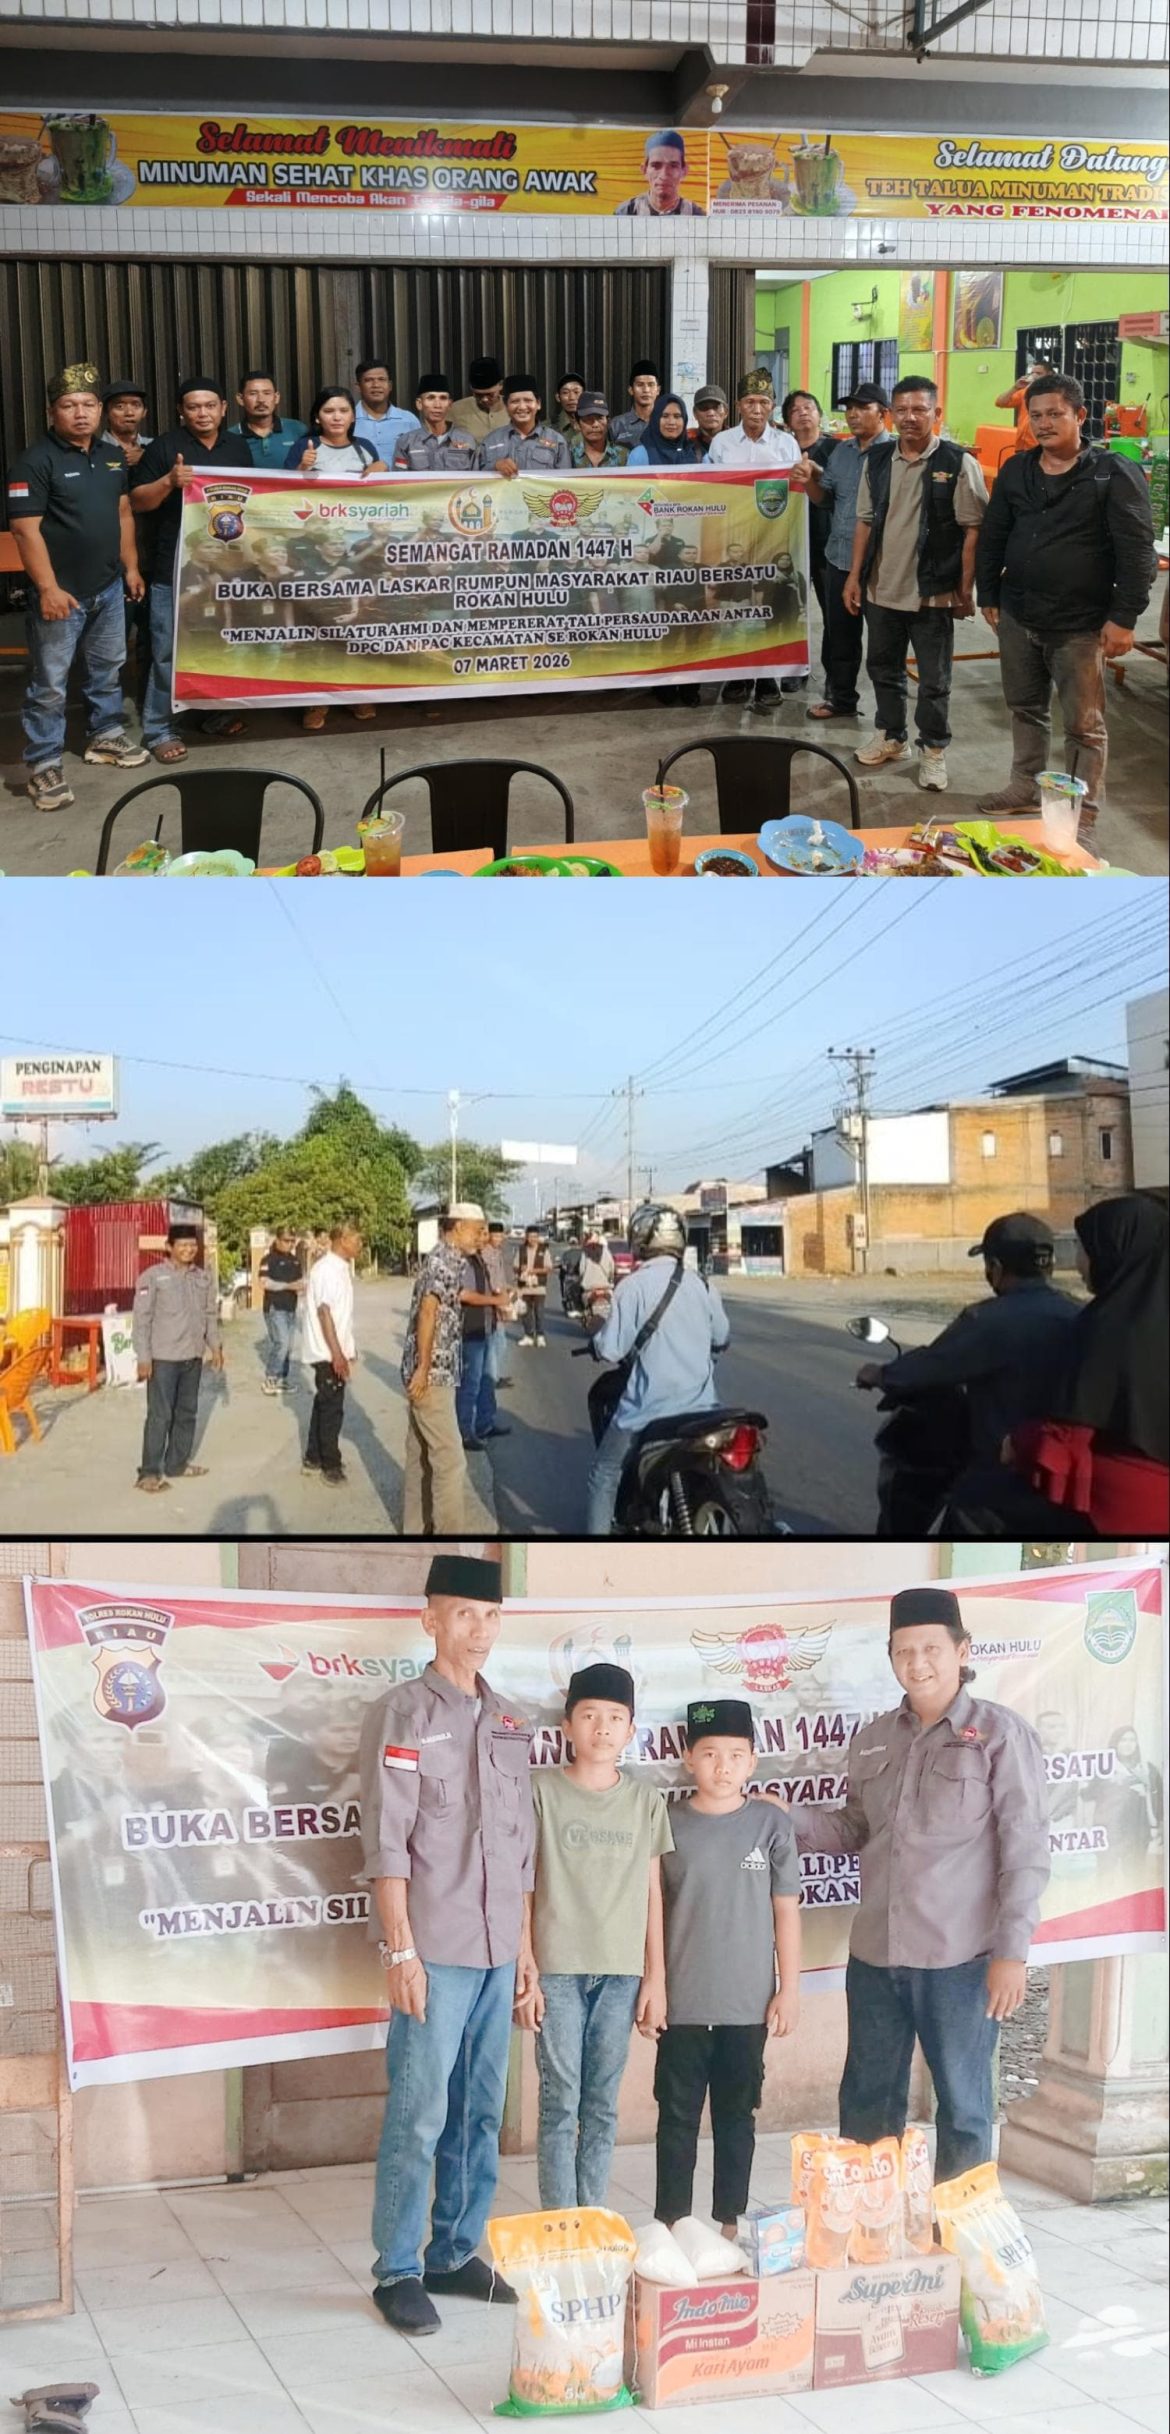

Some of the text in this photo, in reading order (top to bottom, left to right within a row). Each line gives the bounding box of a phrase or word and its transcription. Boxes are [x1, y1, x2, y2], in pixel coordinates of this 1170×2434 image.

[198, 121, 517, 160] Selamat Menikmati
[934, 140, 1167, 182] Selamat Datang
[138, 160, 596, 193] MINUMAN SEHAT KHAS ORANG AWAK
[246, 191, 291, 203] Sekali
[296, 192, 364, 205] Mencoba
[370, 194, 406, 205] Akan
[865, 179, 912, 198] TEH
[914, 179, 989, 199] TALUA
[990, 181, 1095, 201] MINUMAN
[925, 203, 1004, 217] YANG
[319, 503, 409, 520] brksyariah
[676, 505, 704, 513] ROKAN
[705, 504, 727, 512] HULU
[386, 539, 633, 564] SEMANGAT RAMADAN 1447 H
[217, 565, 776, 599] BUKA BERSAMA LASKAR RUMPUN MASYARAKAT RIAU BERSATU
[455, 591, 569, 609] ROKAN HULU
[223, 606, 772, 643] "MENJALIN SILATURAHMI DAN MEMPERERAT TALI PERSAUDARAAN ANTAR
[348, 627, 669, 654] DPC DAN PAC KECAMATAN SE ROKAN HULU"
[453, 653, 570, 674] 07 MARET 2026
[15, 1060, 101, 1076] PENGINAPAN
[22, 1078, 93, 1096] RESTU
[970, 1639, 1041, 1656] OKAN HULU
[126, 1805, 361, 1846] BUKA BERSA
[1048, 1829, 1106, 1853] NTAR
[551, 2293, 621, 2324] SPHP
[685, 2337, 731, 2351] Mi Instan
[691, 2357, 770, 2378] Kari Ayam
